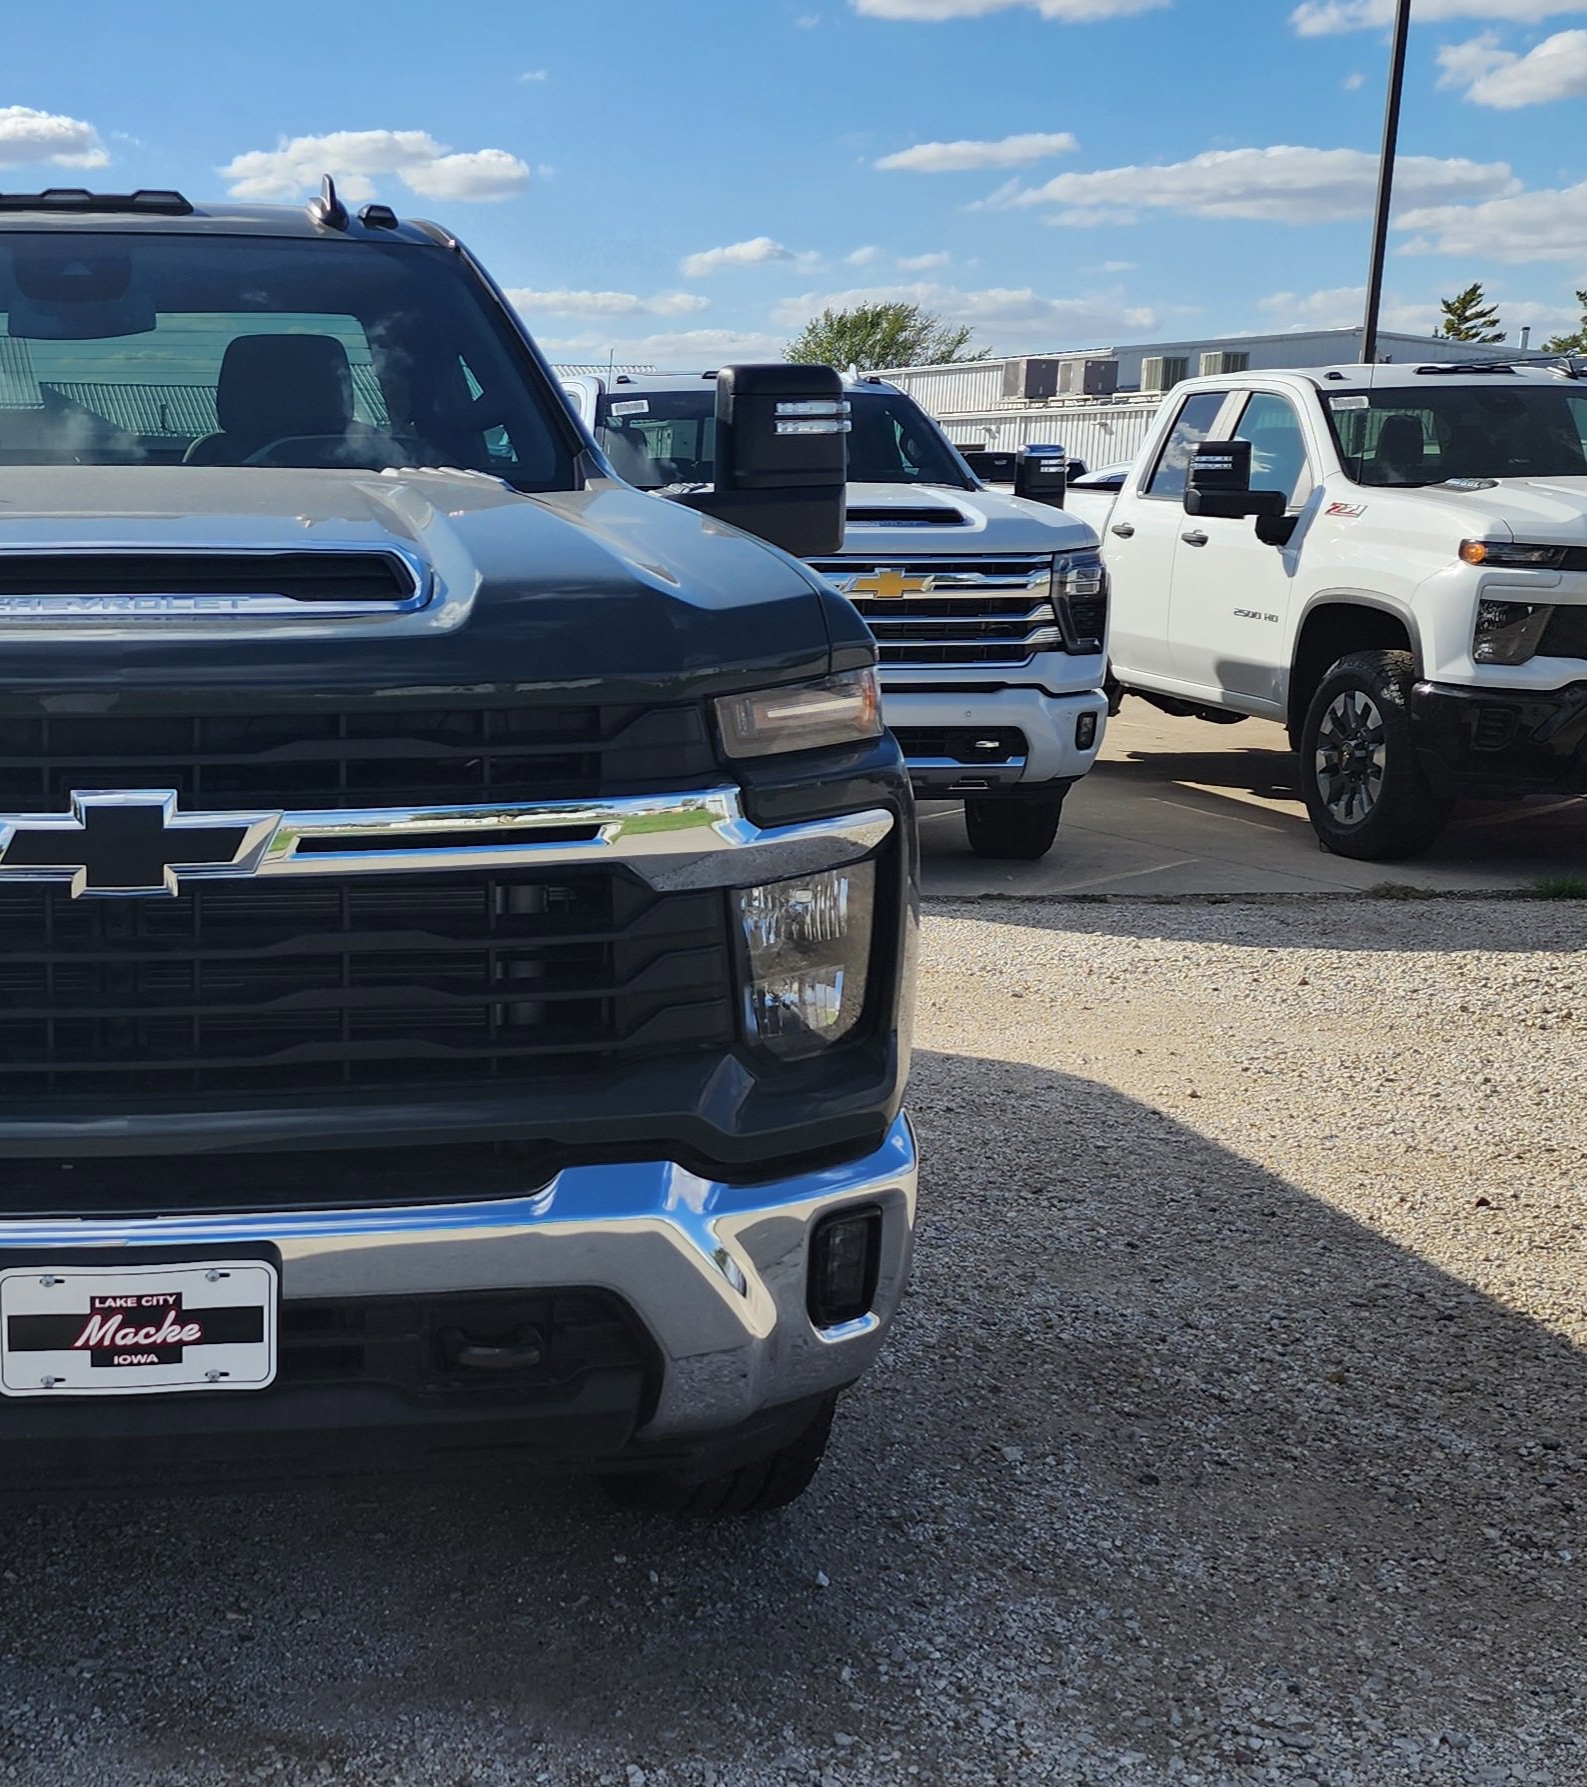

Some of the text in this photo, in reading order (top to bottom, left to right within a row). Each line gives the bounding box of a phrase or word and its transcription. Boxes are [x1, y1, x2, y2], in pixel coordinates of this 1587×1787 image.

[95, 1295, 177, 1308] LAKE CITY
[73, 1309, 202, 1347] Macke
[114, 1354, 159, 1365] IOWA
